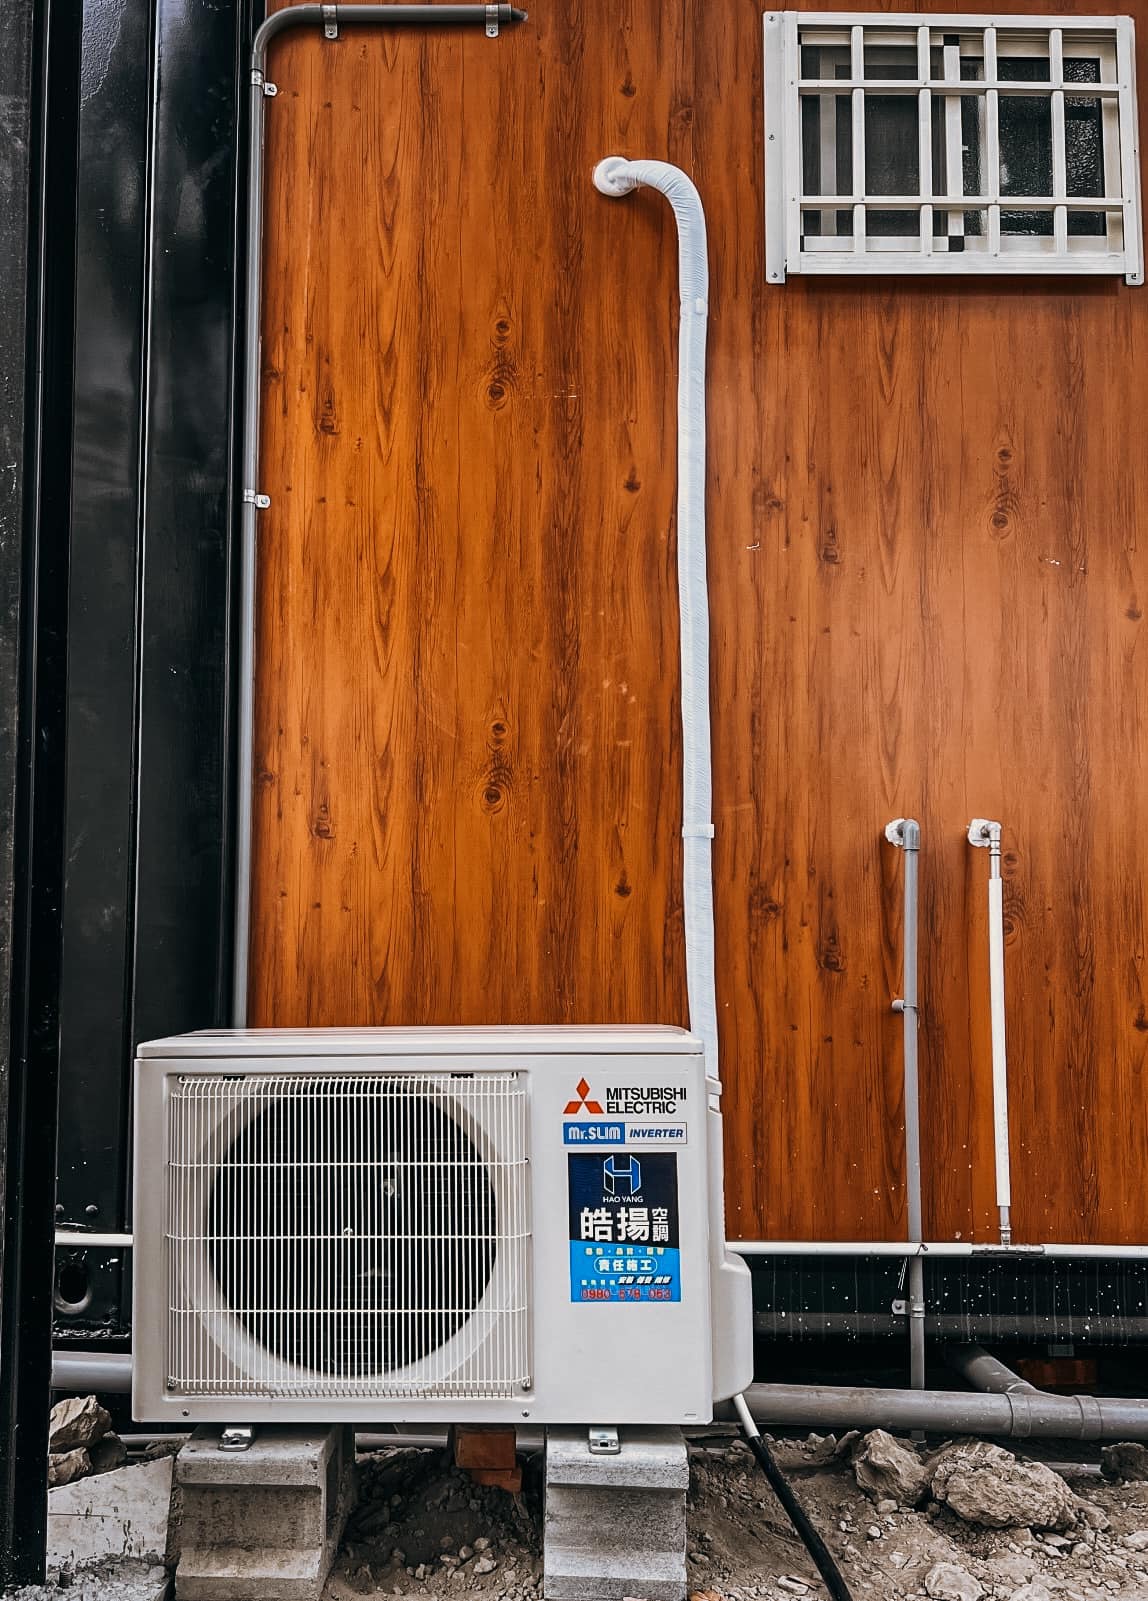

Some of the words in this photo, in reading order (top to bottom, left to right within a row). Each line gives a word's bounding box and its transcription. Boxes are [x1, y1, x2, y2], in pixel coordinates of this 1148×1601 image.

[606, 1087, 687, 1101] MITSUBISHI
[606, 1101, 677, 1114] ELECTRIC
[568, 1126, 621, 1140] Mr.SLIM
[629, 1128, 684, 1138] INVERTER
[602, 1195, 621, 1203] HAO
[621, 1195, 644, 1203] YANG
[580, 1206, 650, 1242] 皓揚
[651, 1206, 669, 1242] 空調
